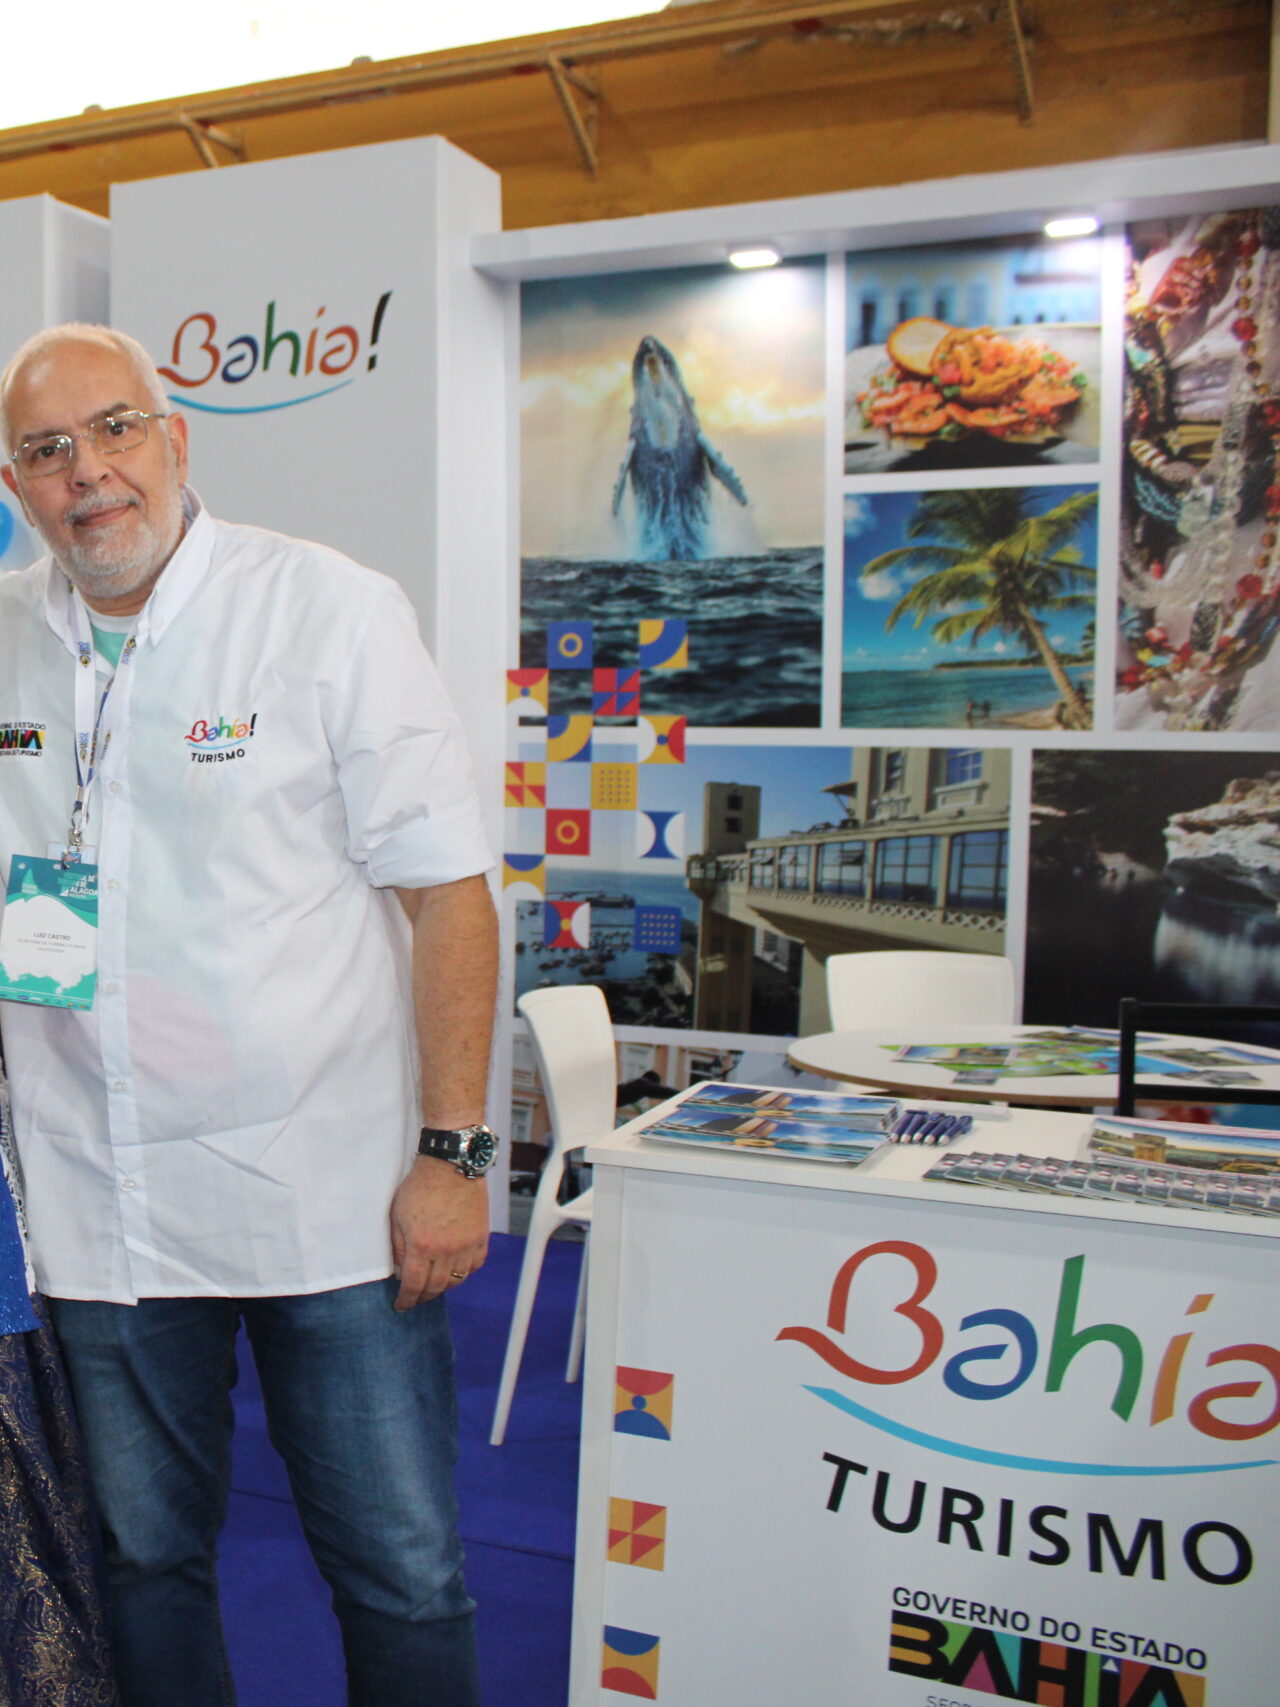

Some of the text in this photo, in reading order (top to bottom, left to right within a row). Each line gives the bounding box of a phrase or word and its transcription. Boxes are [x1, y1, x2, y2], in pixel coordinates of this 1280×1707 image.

[191, 749, 245, 763] TURISMO
[821, 1452, 1254, 1586] TURISMO
[888, 1609, 1207, 1707] BAHIA
[892, 1586, 1208, 1671] GOVERNO DO ESTADO
